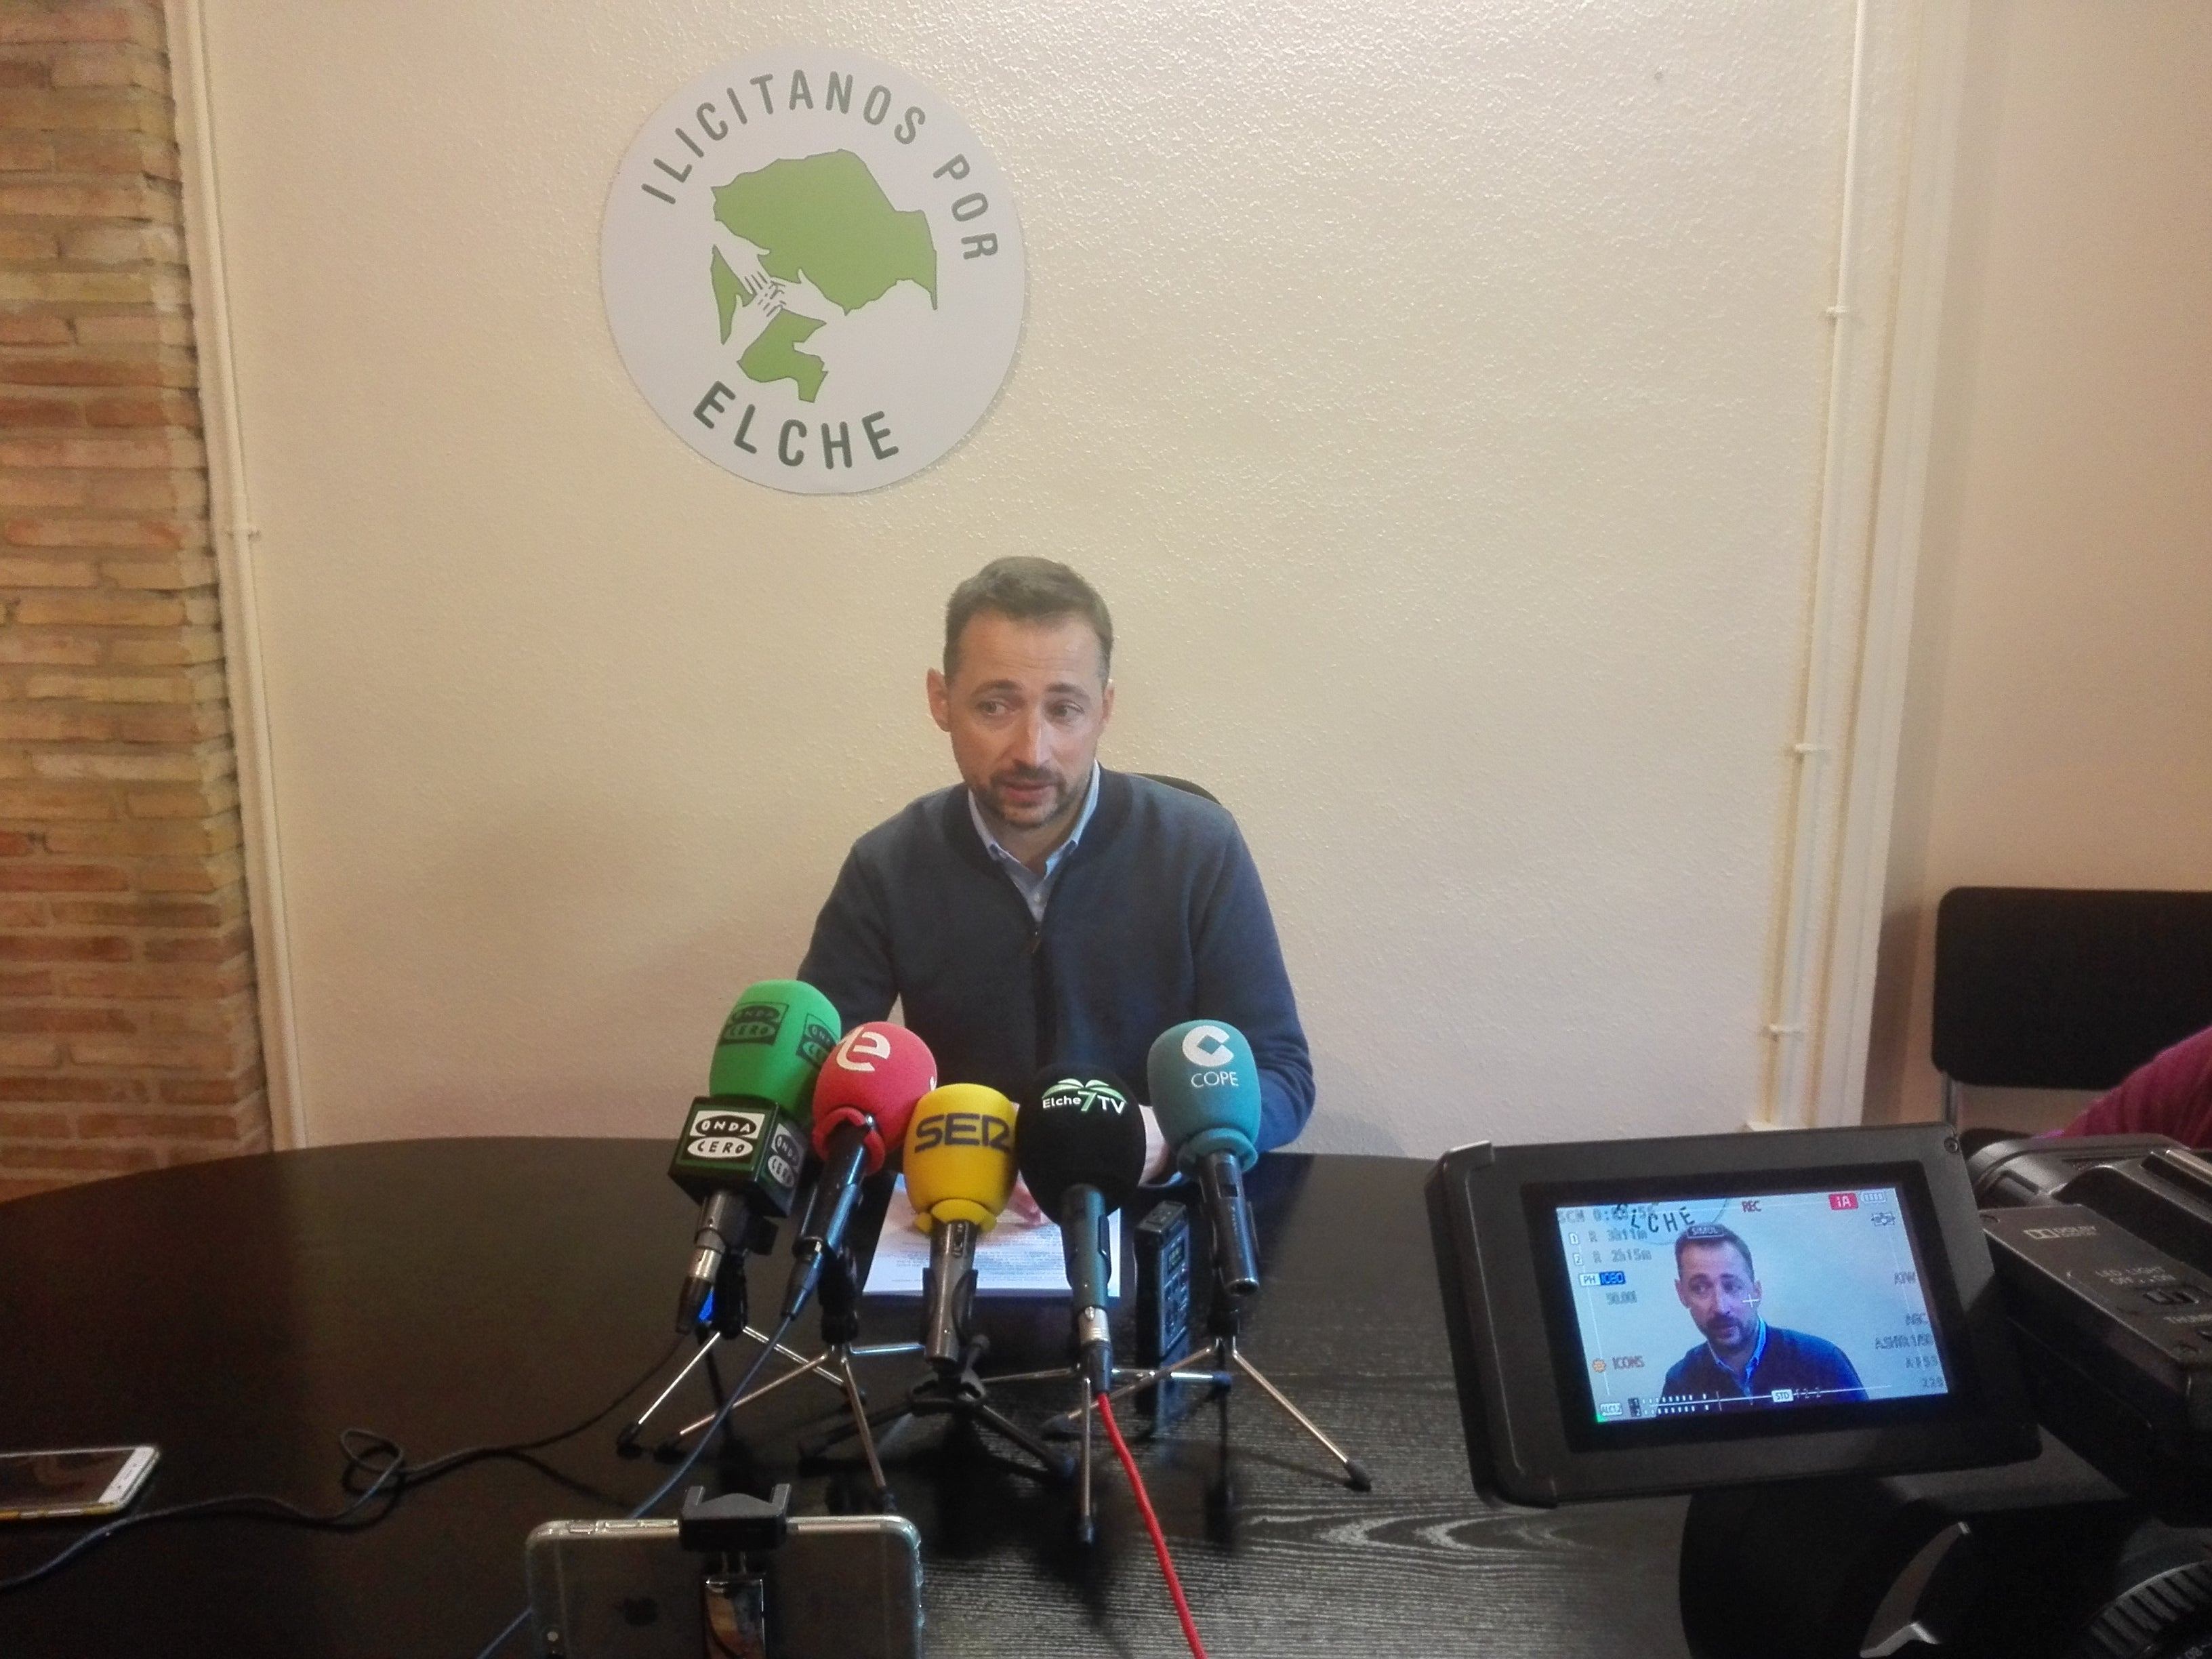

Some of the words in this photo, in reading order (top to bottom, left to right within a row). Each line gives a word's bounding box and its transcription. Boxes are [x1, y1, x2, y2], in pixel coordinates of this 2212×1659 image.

[641, 69, 926, 204] ILICITANOS
[933, 153, 999, 260] POR
[693, 381, 899, 470] ELCHE
[1191, 1071, 1239, 1088] COPE
[701, 1120, 751, 1132] ONDA
[914, 1113, 1010, 1153] SER
[697, 1141, 745, 1153] CERO
[1742, 1200, 1761, 1212] REC
